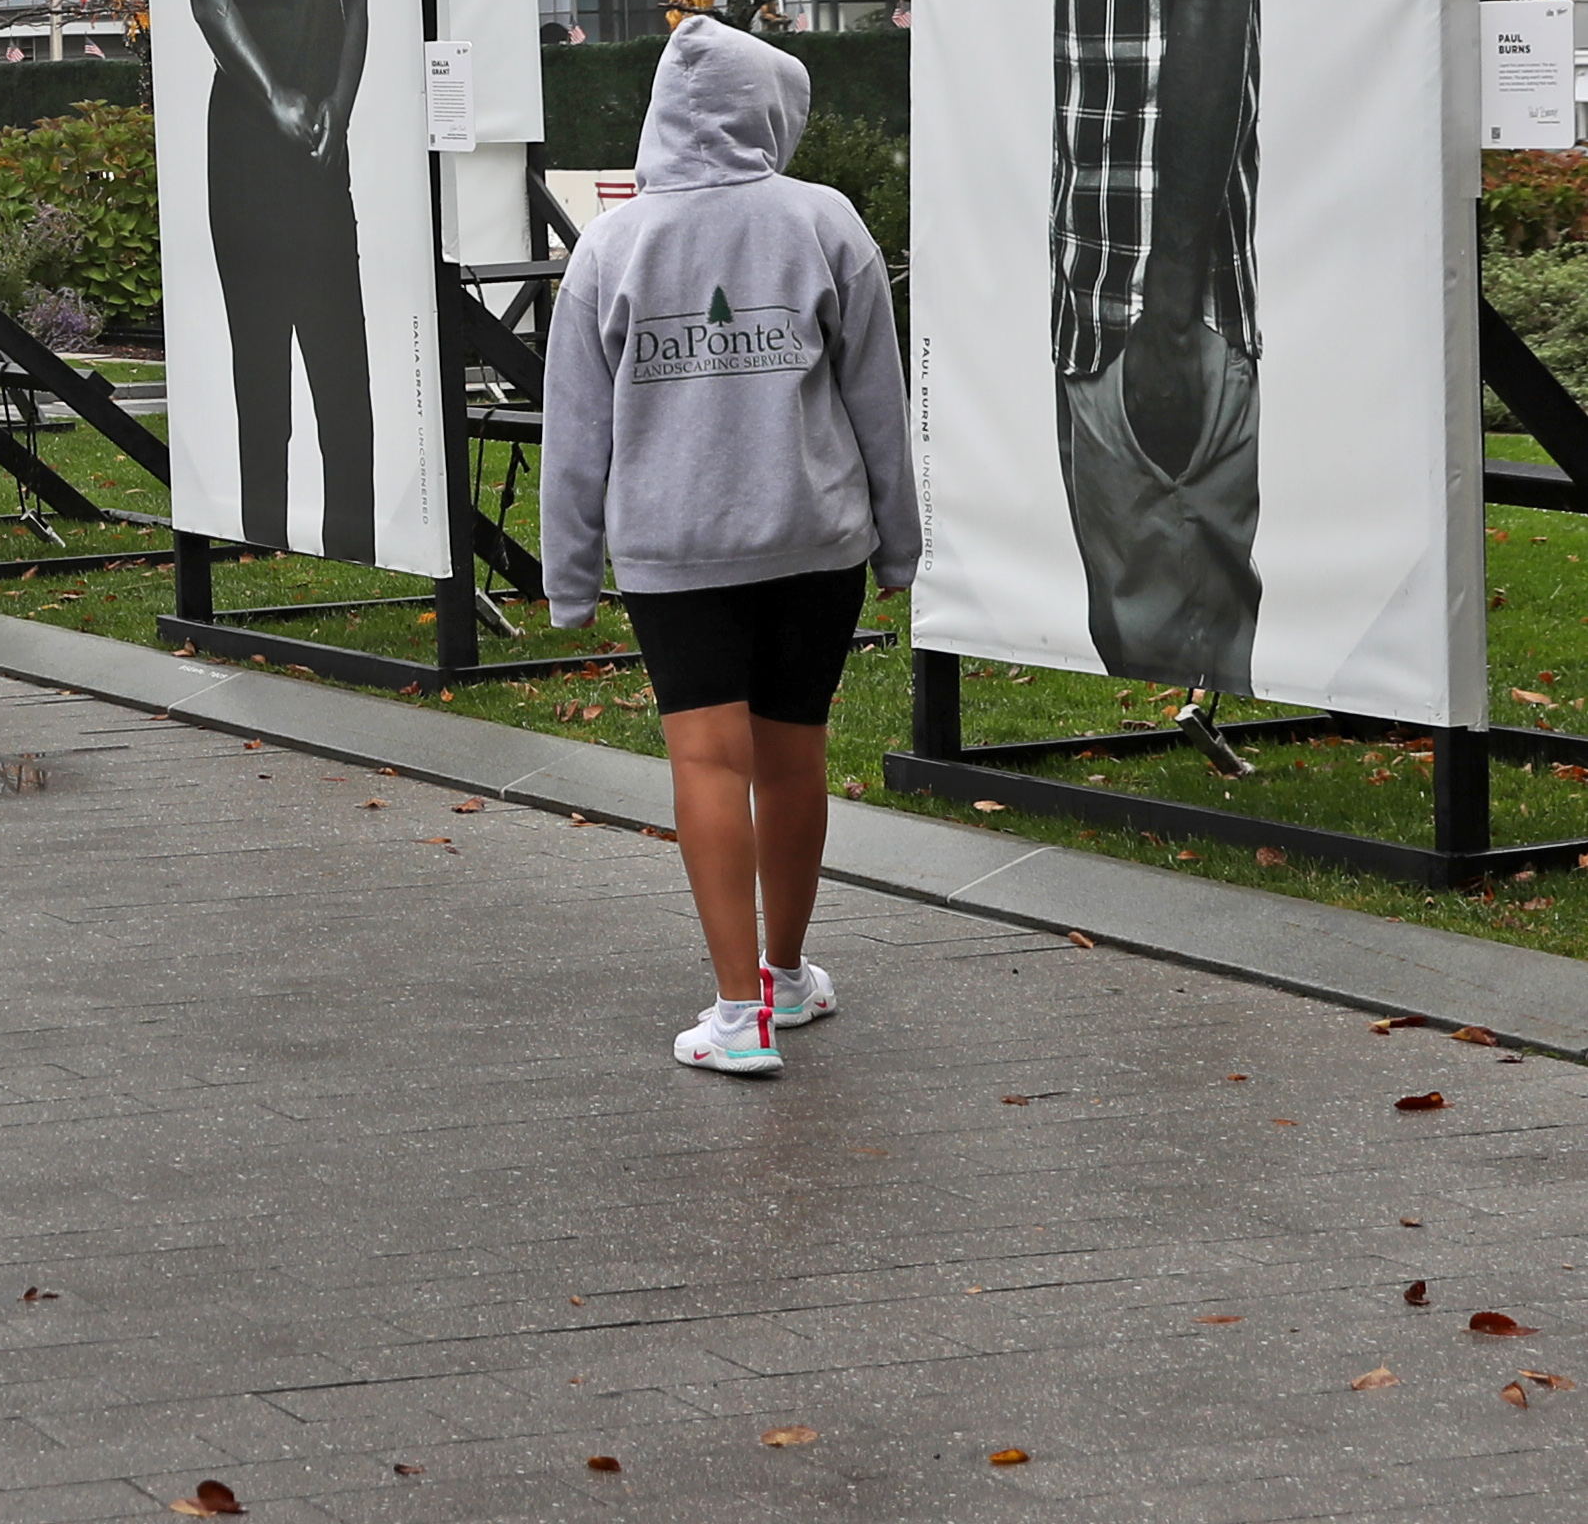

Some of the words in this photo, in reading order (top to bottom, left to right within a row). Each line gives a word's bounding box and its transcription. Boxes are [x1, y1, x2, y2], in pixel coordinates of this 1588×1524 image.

[1498, 33, 1523, 43] PAUL
[1498, 44, 1532, 54] BURNS
[431, 60, 450, 68] IDALIA
[431, 68, 451, 76] GRANT
[412, 315, 421, 363] IDALIA
[634, 318, 804, 364] DaPonte's
[921, 337, 931, 381] PAUL
[632, 357, 740, 379] LANDSCAPING
[743, 352, 810, 369] SERVICES
[414, 369, 423, 418] GRANT
[921, 387, 931, 443] BURNS
[417, 427, 429, 526] UNCORNERED
[922, 455, 935, 571] UNCORNERED
